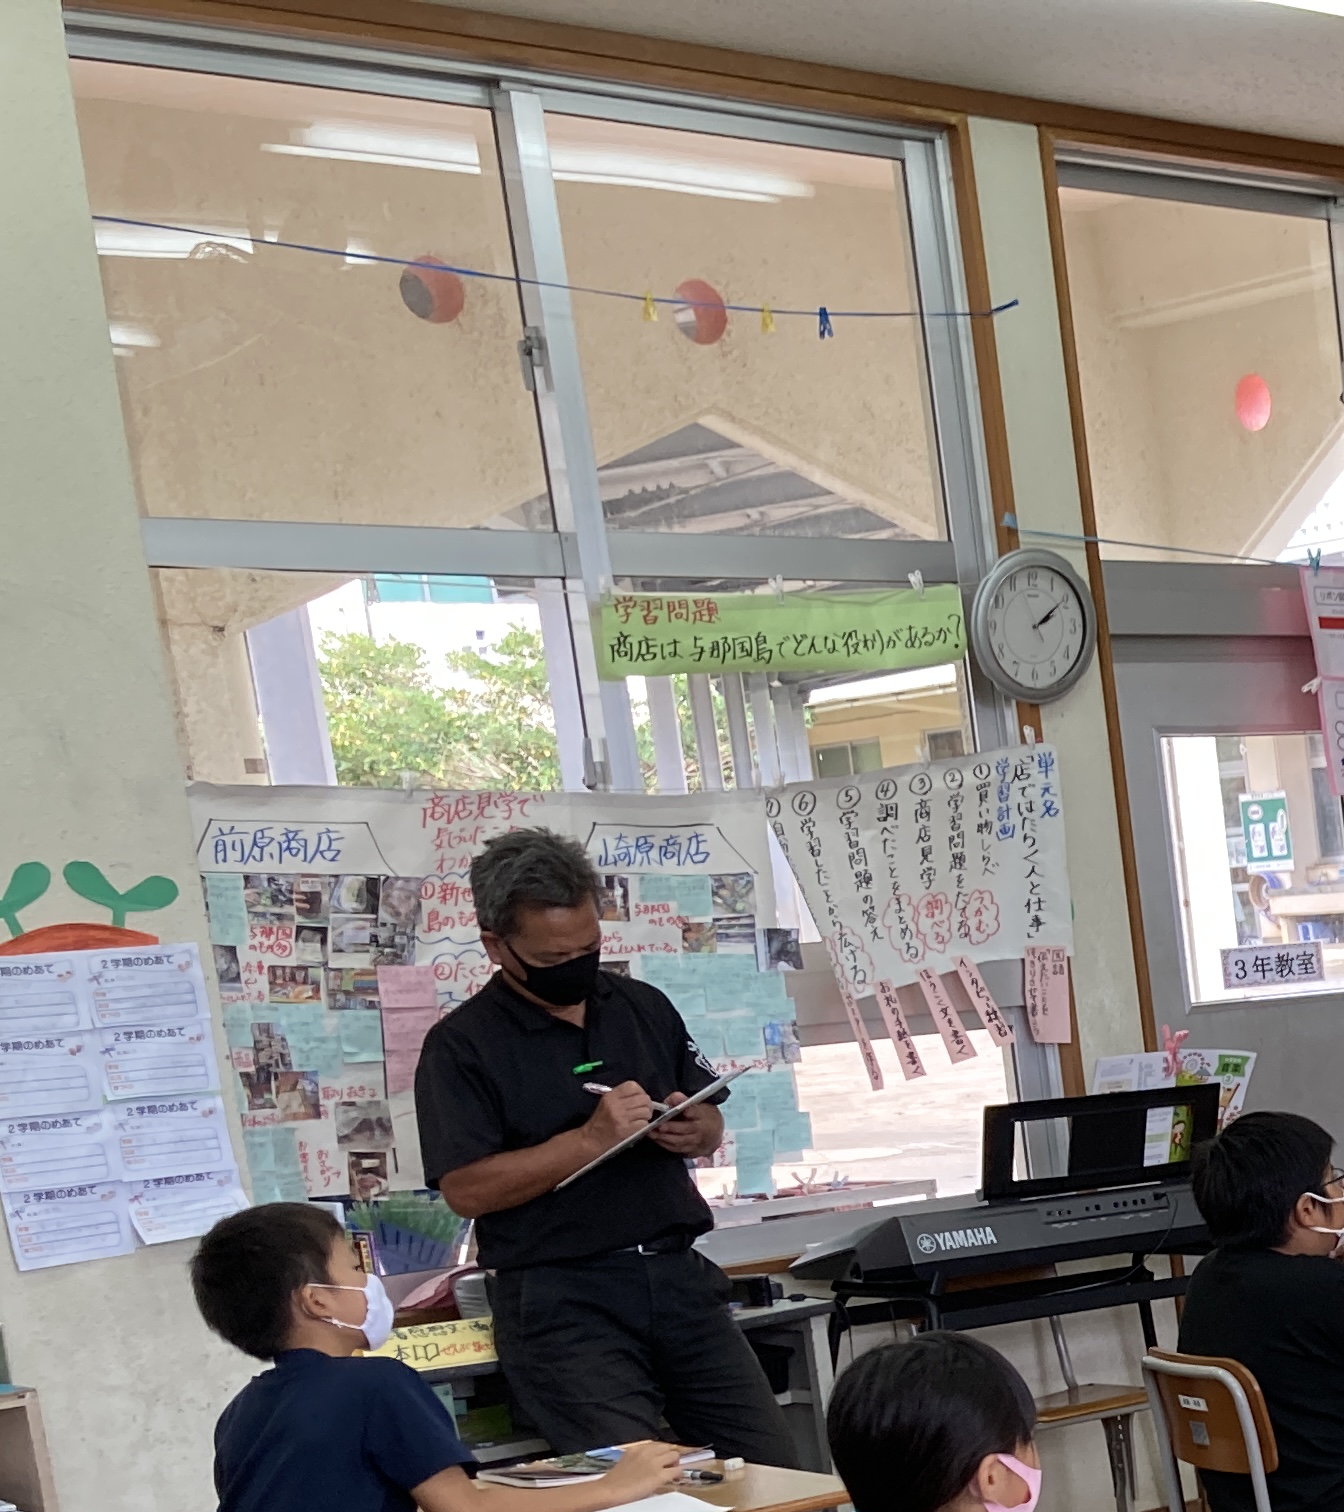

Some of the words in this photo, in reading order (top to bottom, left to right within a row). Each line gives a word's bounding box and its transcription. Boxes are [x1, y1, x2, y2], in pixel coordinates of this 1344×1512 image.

[1009, 576, 1017, 592] 11
[1027, 571, 1038, 588] 12
[1050, 576, 1054, 593] 1
[994, 594, 1005, 610] 10
[1062, 593, 1070, 609] 2
[613, 596, 722, 626] 学習問題
[990, 617, 997, 635] 9
[1069, 617, 1077, 636] 3
[997, 643, 1005, 660] 8
[1063, 645, 1071, 660] 4
[1012, 660, 1020, 679] 7
[1031, 666, 1039, 681] 6
[1049, 661, 1057, 677] 5
[1036, 751, 1060, 819] 単元名
[995, 757, 1017, 842] 学習計画
[422, 792, 546, 829] 商店見学で
[211, 825, 346, 866] 前原商店
[599, 832, 711, 868] 崎原商店
[100, 953, 176, 971] 2学期のめあて
[1234, 949, 1319, 982] 3年教室
[113, 1026, 187, 1042] 2学期のめあて
[126, 1100, 199, 1118] 2学期のめあて
[7, 1116, 83, 1134] 2学期のめあて
[23, 1184, 99, 1205] 2学期のめあて
[934, 1225, 998, 1252] YAMAHA
